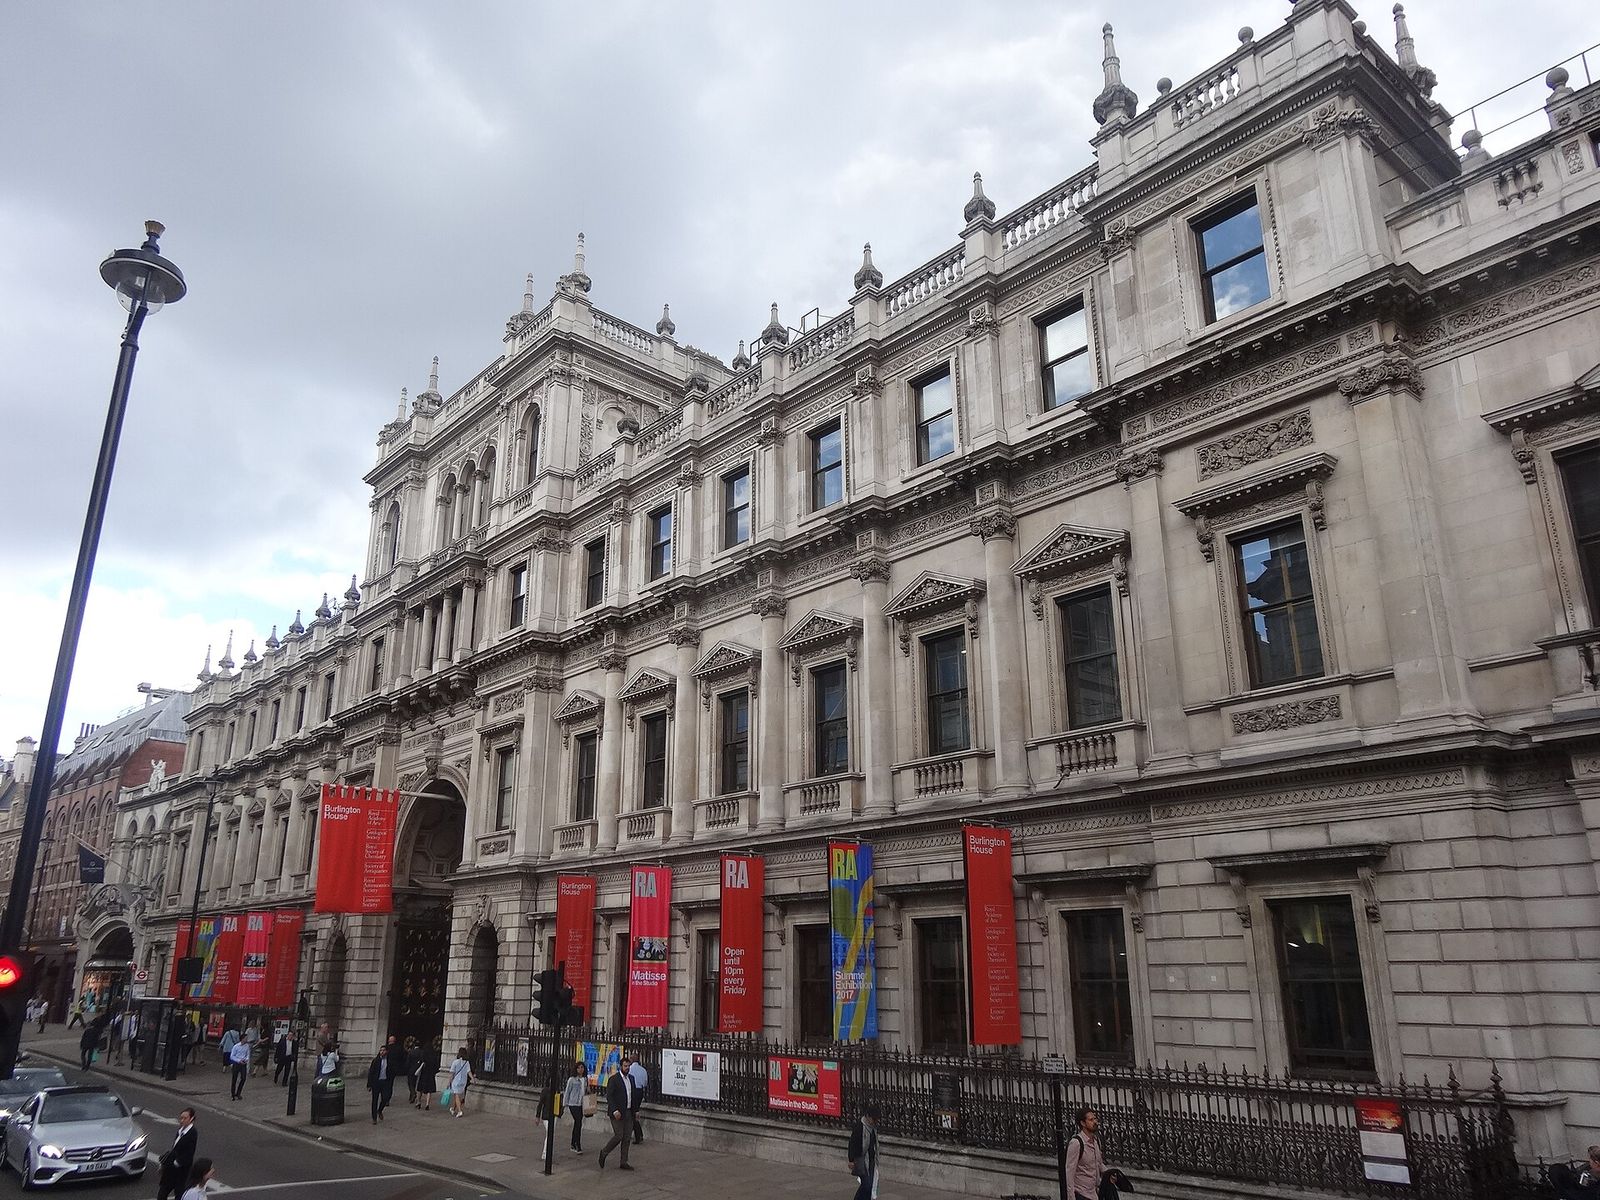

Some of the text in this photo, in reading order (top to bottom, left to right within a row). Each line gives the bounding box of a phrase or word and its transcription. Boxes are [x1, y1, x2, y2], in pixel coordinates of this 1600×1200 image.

[324, 804, 361, 814] Burlington
[324, 812, 348, 820] House
[970, 835, 1005, 847] Burlington
[970, 844, 993, 854] House
[833, 849, 858, 880] RA
[726, 860, 749, 888] RA
[561, 882, 592, 890] Burlington
[635, 872, 657, 897] RA
[200, 920, 214, 935] RA
[222, 917, 238, 932] RA
[248, 916, 263, 930] RA
[724, 947, 744, 956] Open
[632, 971, 667, 980] Matisse
[725, 966, 744, 976] 10pm
[724, 978, 744, 986] every
[836, 980, 872, 989] Exhibition
[724, 986, 747, 996] Friday
[836, 990, 854, 999] 2017
[770, 1060, 781, 1080] RA
[770, 1097, 788, 1107] Matisse
[802, 1102, 818, 1111] Studio
